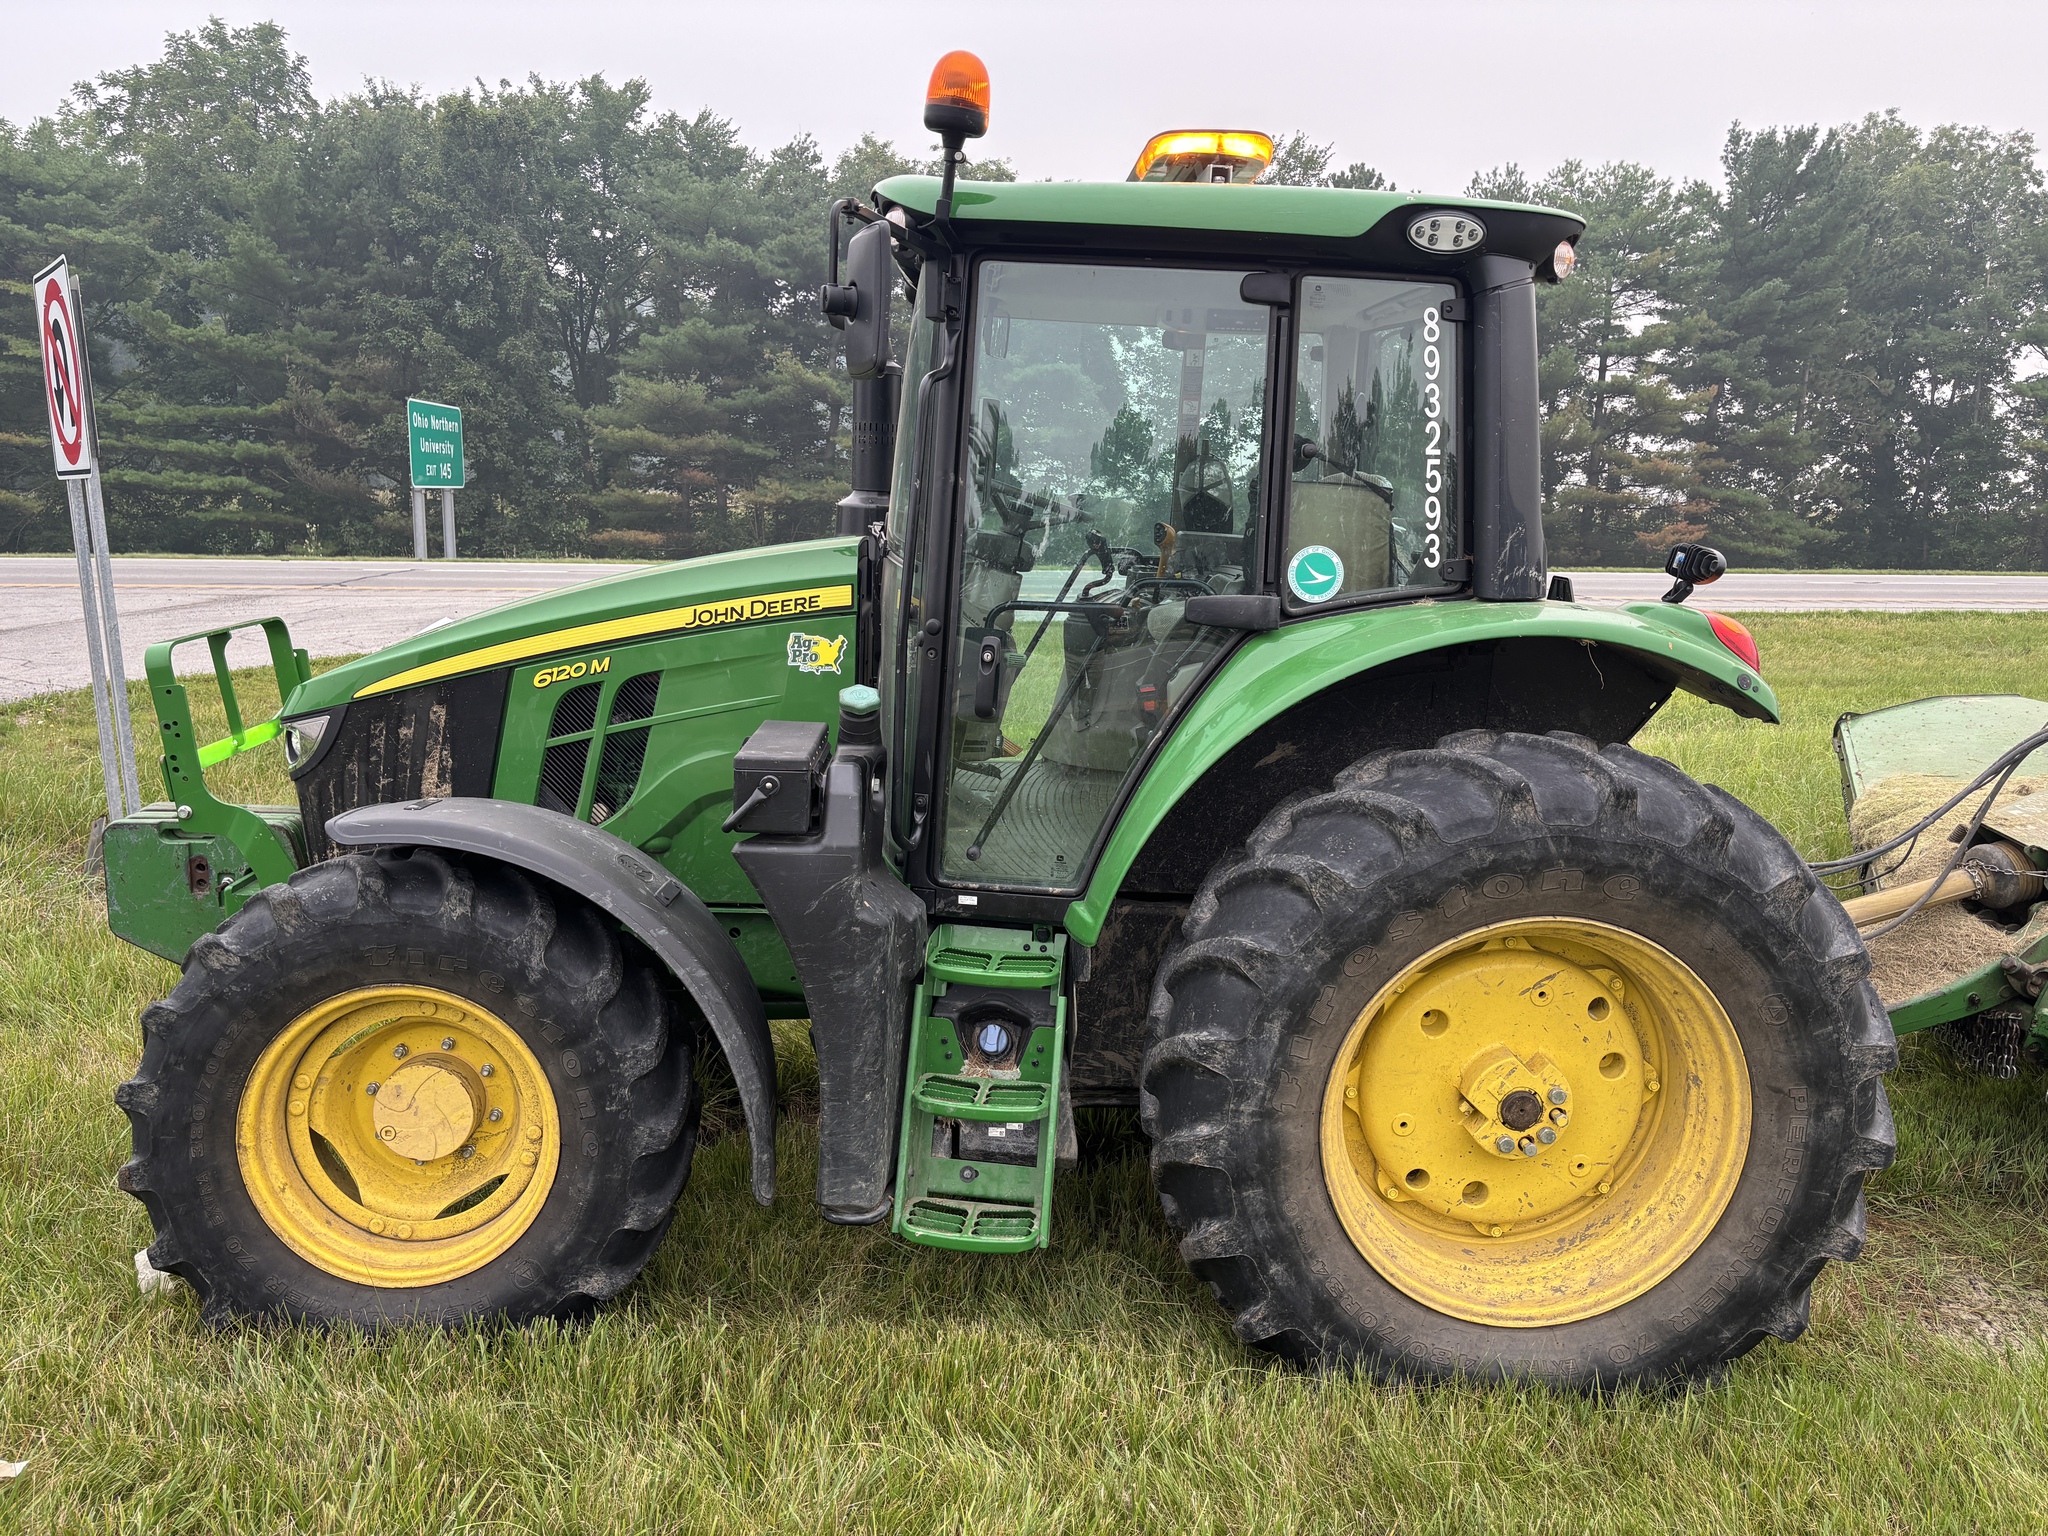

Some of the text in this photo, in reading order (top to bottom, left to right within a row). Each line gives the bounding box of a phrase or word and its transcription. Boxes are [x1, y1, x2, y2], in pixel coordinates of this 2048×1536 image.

[412, 411, 459, 433] Ohio Northern
[1423, 307, 1441, 568] 8932593
[420, 437, 454, 458] University
[426, 463, 452, 479] EXIT 145
[1296, 549, 1310, 561] STATE
[1321, 549, 1335, 559] OHIO
[1290, 565, 1307, 597] DEPARTMENT
[1317, 561, 1341, 600] TRANSPORTATION
[685, 595, 821, 627] JOHN DEERE
[791, 635, 819, 652] Ag-
[791, 649, 819, 663] Pro
[532, 656, 611, 689] 6120 M
[190, 1008, 257, 1160] 380/70R24
[196, 1171, 224, 1227] EXTRA
[1668, 1086, 1809, 1334] PERFORMER
[225, 1235, 258, 1272] 70
[1310, 1260, 1477, 1371] 480/70R34
[1607, 1333, 1659, 1365] 70
